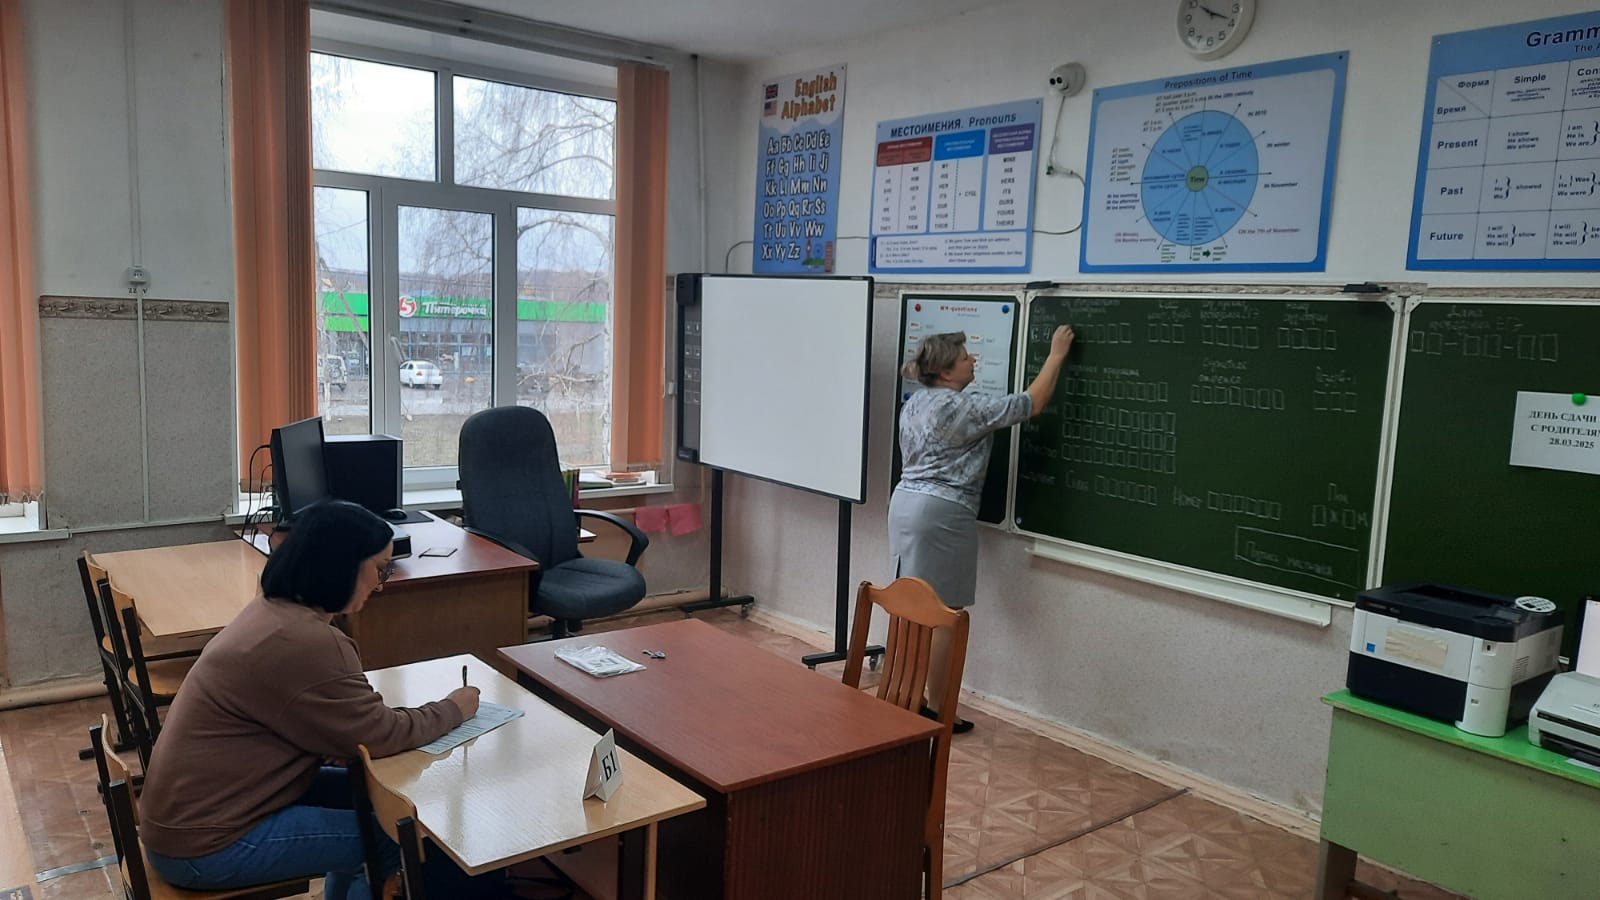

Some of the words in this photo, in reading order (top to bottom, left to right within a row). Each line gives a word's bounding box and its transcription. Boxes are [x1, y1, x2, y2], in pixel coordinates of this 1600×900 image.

[1232, 3, 1239, 13] 3
[1185, 14, 1192, 24] 9
[1227, 18, 1235, 28] 4
[1188, 27, 1195, 37] 8
[1218, 30, 1226, 40] 5
[1206, 36, 1214, 47] 6
[1575, 44, 1592, 53] The
[1514, 72, 1547, 85] Simple
[1577, 68, 1600, 77] Con
[794, 72, 838, 98] English
[1164, 75, 1216, 89] Prepositions
[1219, 72, 1229, 83] of
[1231, 70, 1253, 80] Time
[1457, 79, 1490, 89] Форма
[781, 94, 836, 121] Alphabet
[1436, 104, 1466, 116] Время
[969, 113, 1017, 128] Pronouns
[767, 137, 779, 155] Aa
[781, 136, 792, 152] Bb
[805, 131, 818, 150] Dd
[819, 129, 831, 148] Ee
[1437, 138, 1478, 150] Present
[765, 159, 775, 176] Ff
[778, 157, 789, 175] Gg
[793, 155, 805, 174] Hh
[809, 154, 816, 172] Ii
[819, 153, 829, 172] Jj
[764, 180, 777, 196] Kk
[779, 179, 788, 195] Ll
[790, 178, 810, 194] Mm
[812, 176, 827, 193] Nn
[1440, 186, 1464, 196] Past
[776, 200, 786, 219] Pp
[788, 200, 800, 218] Qq
[802, 199, 814, 217] Rr
[775, 222, 787, 238] Uu
[788, 222, 800, 238] Vv
[804, 220, 824, 237] Ww
[1429, 232, 1464, 241] Future
[775, 243, 786, 263] Yy
[787, 242, 800, 259] Zz
[1528, 410, 1558, 420] ДЕНЬ
[1561, 412, 1597, 423] СДАЧИ
[1549, 437, 1595, 449] 28.03.2025
[602, 750, 618, 782] Б1
